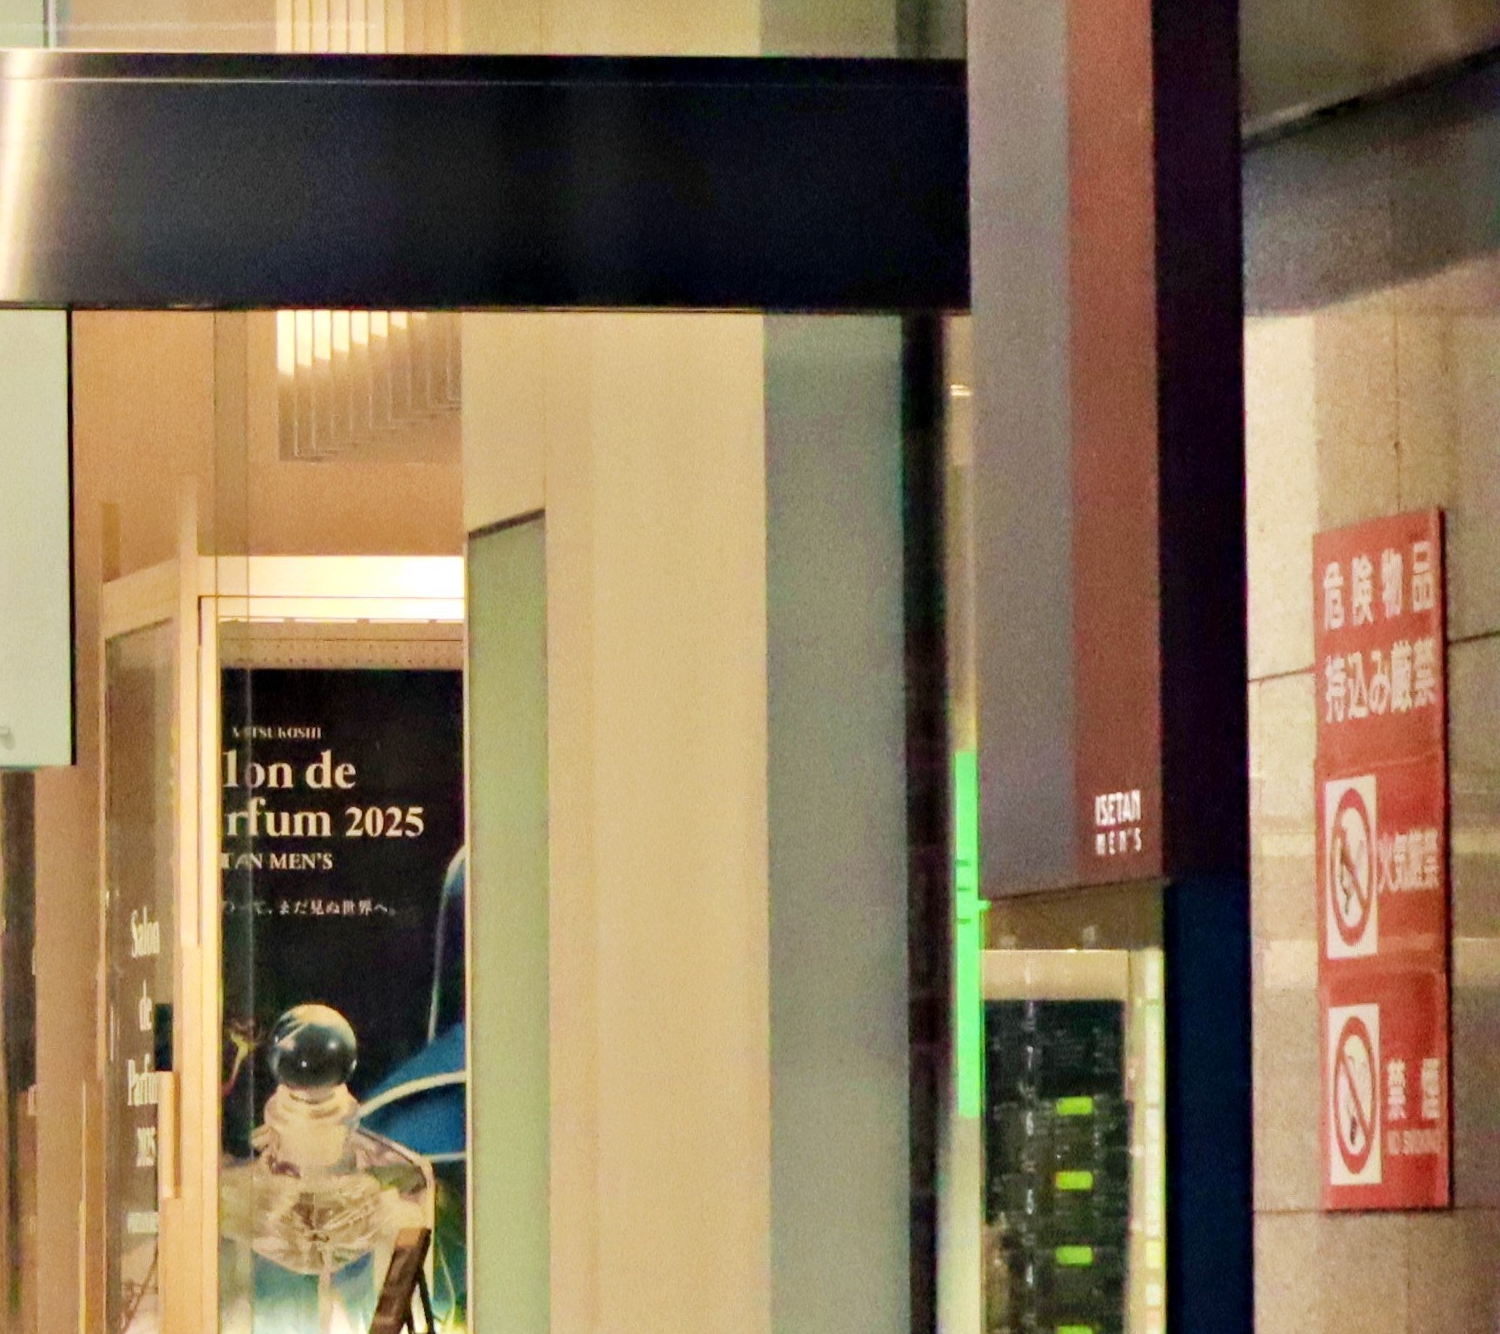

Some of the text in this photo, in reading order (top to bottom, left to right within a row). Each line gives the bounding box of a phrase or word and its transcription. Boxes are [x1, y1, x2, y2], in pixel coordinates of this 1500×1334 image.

[1324, 541, 1435, 630] 危険物品
[1325, 636, 1437, 723] 持込み厳禁
[305, 749, 357, 789] de
[345, 806, 425, 837] 2025
[1094, 790, 1141, 826] ISETAN
[269, 852, 333, 870] MEN'S
